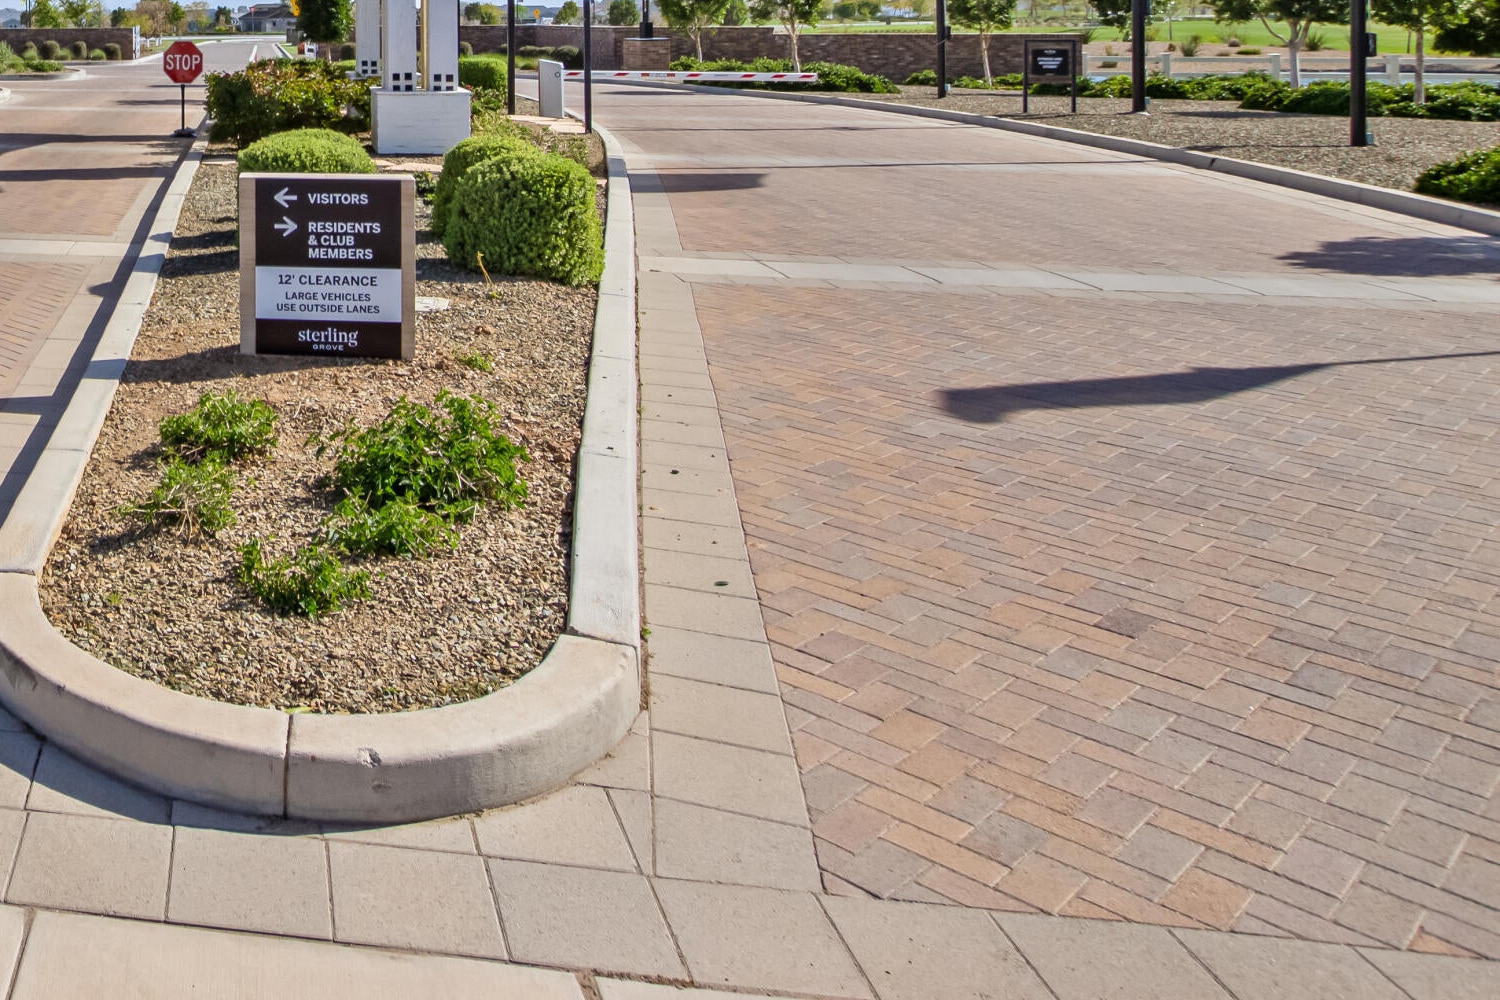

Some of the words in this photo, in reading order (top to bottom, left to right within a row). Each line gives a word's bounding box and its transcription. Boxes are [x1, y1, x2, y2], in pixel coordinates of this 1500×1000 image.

[166, 54, 201, 70] STOP
[308, 193, 369, 205] VISITORS
[308, 222, 381, 234] RESIDENTS
[308, 235, 317, 246] &
[320, 235, 355, 246] CLUB
[308, 248, 373, 260] MEMBERS
[278, 274, 296, 285] 12'
[299, 275, 378, 287] CLEARANCE
[285, 292, 319, 301] LARGE
[321, 292, 371, 302] VEHICLES
[276, 303, 296, 312] USE
[299, 304, 344, 313] OUTSIDE
[346, 305, 380, 314] LANES
[298, 327, 359, 347] sterling
